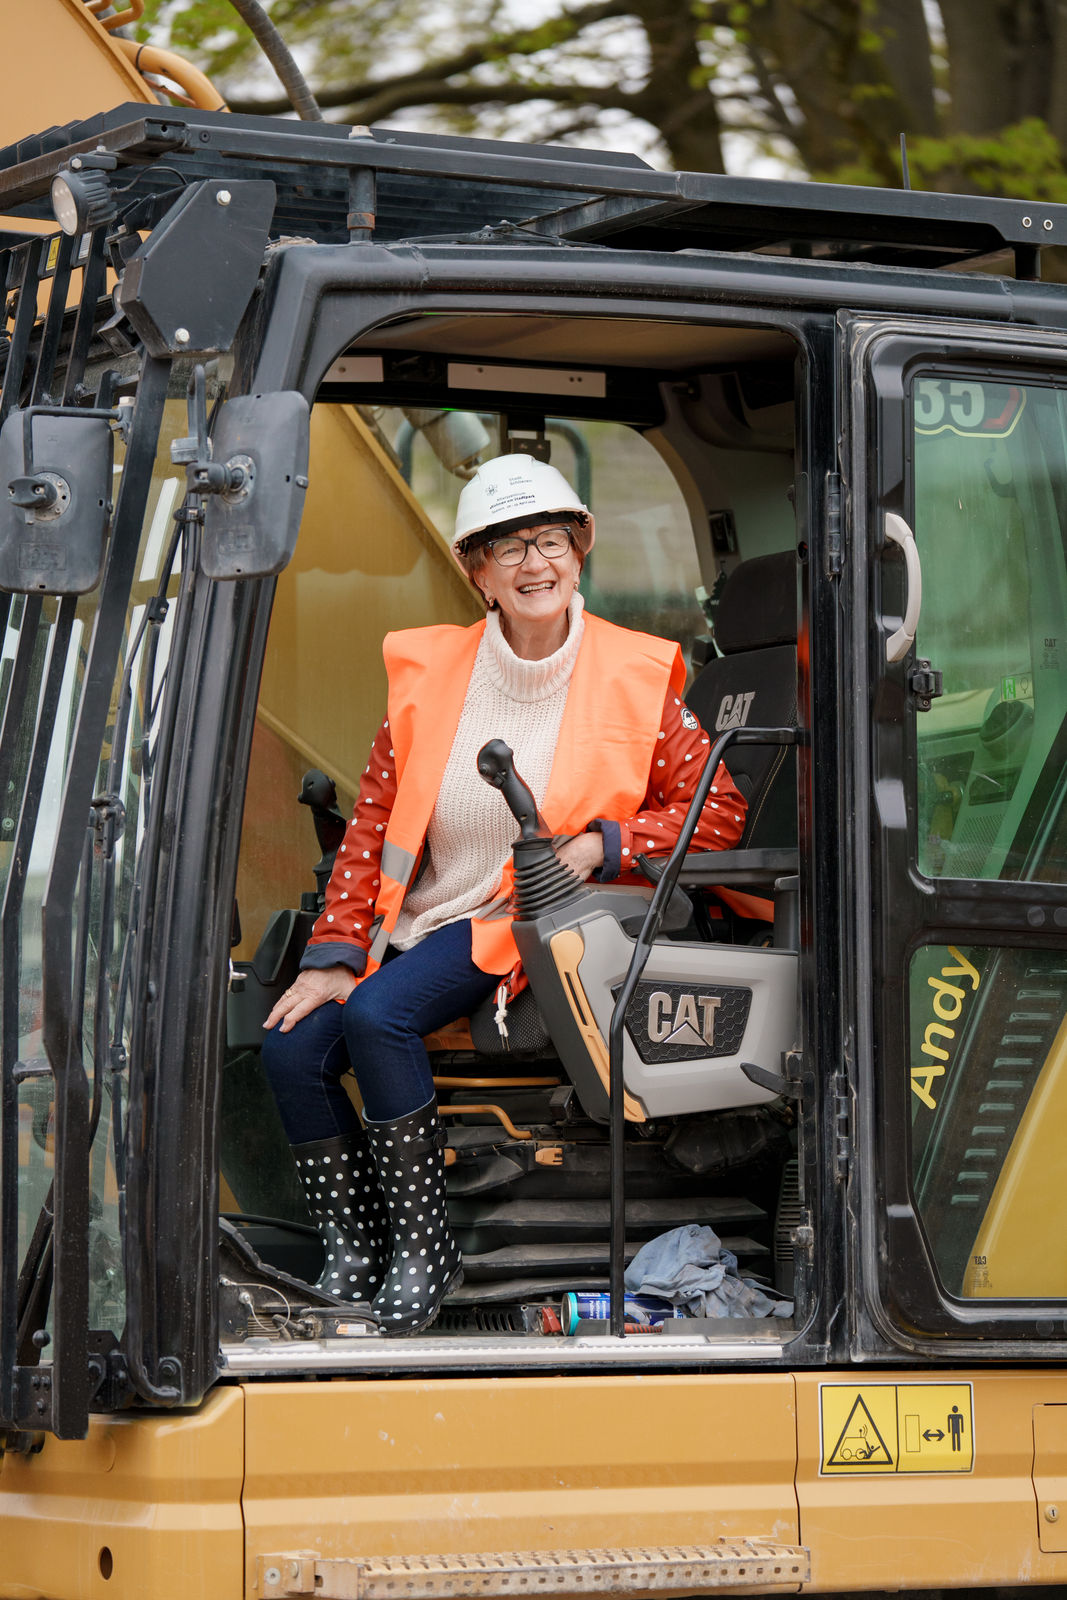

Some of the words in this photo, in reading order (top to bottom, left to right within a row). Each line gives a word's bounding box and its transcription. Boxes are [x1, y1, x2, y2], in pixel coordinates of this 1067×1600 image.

[1044, 638, 1057, 648] CAT
[715, 691, 756, 731] CAT
[647, 991, 721, 1047] CAT
[911, 946, 981, 1110] Andy
